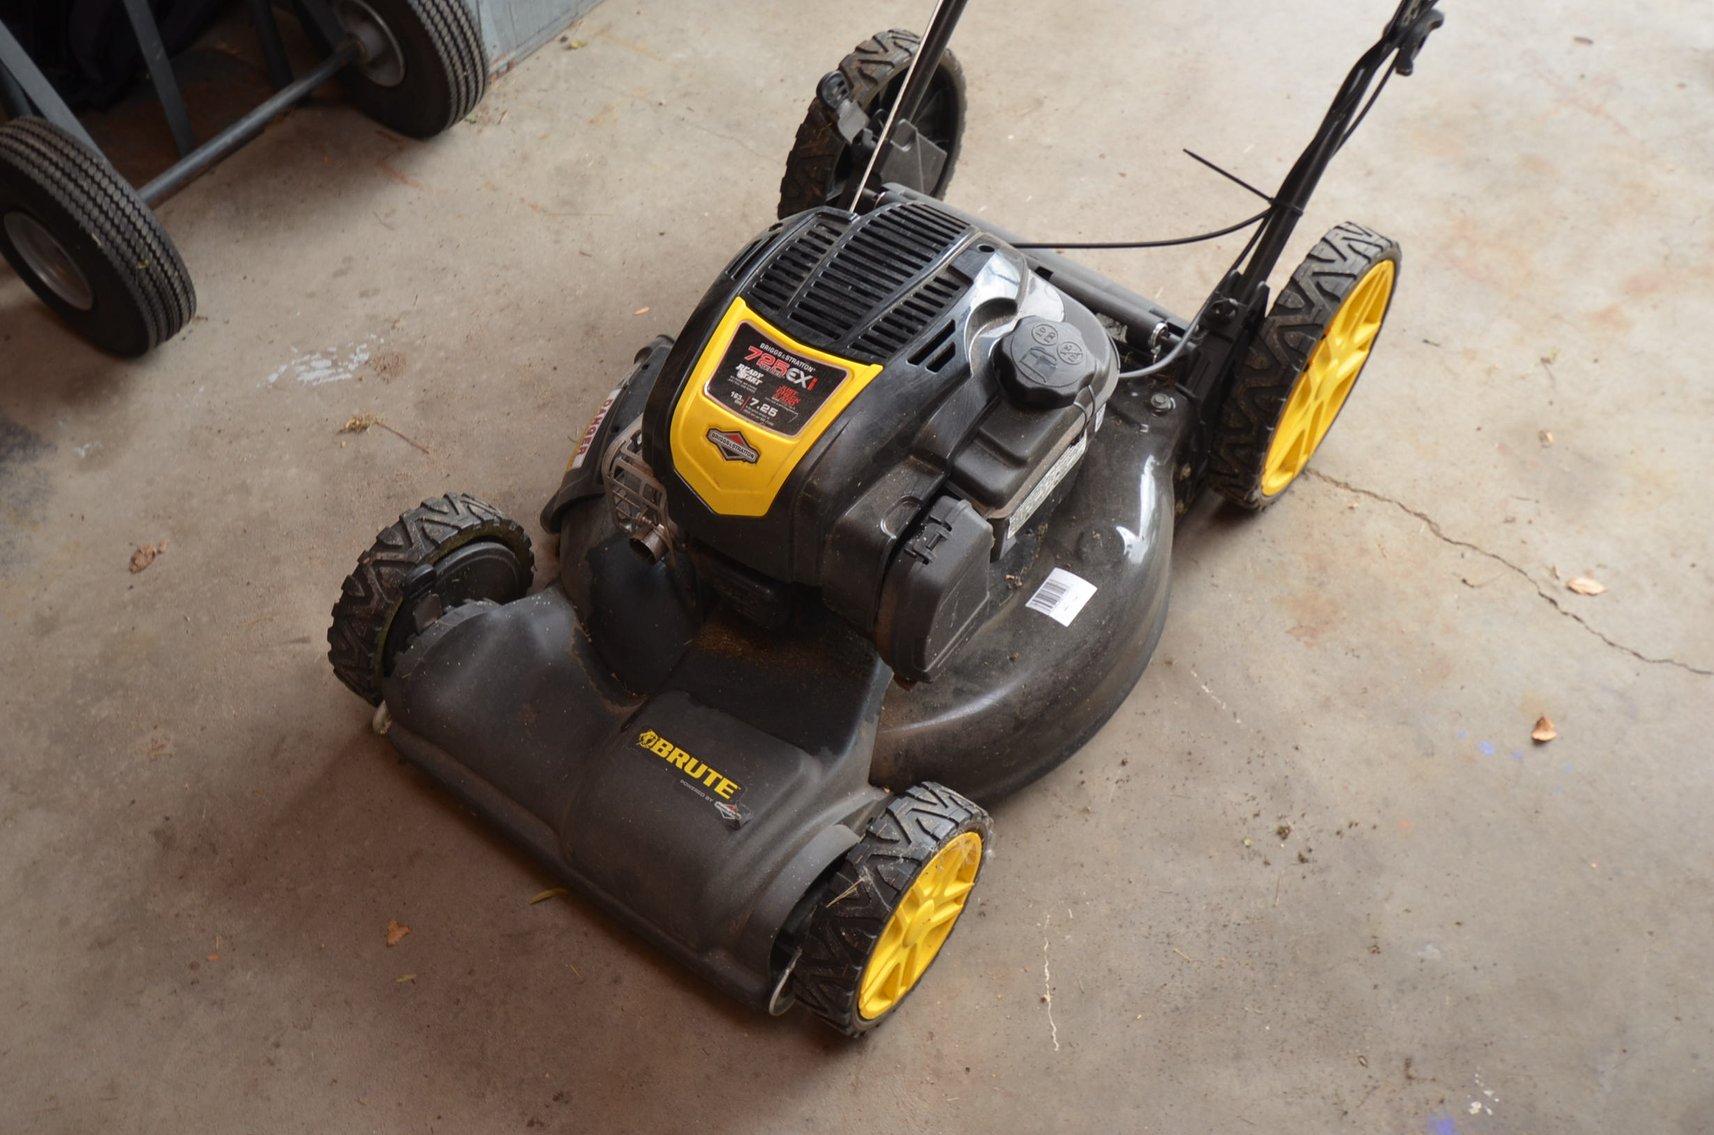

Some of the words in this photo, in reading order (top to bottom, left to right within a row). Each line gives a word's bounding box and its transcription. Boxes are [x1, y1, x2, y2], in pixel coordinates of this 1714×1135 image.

[735, 363, 764, 379] READY
[736, 369, 762, 385] START
[748, 396, 778, 417] 7.25
[650, 738, 739, 799] BRUTE
[679, 779, 705, 797] POWERED
